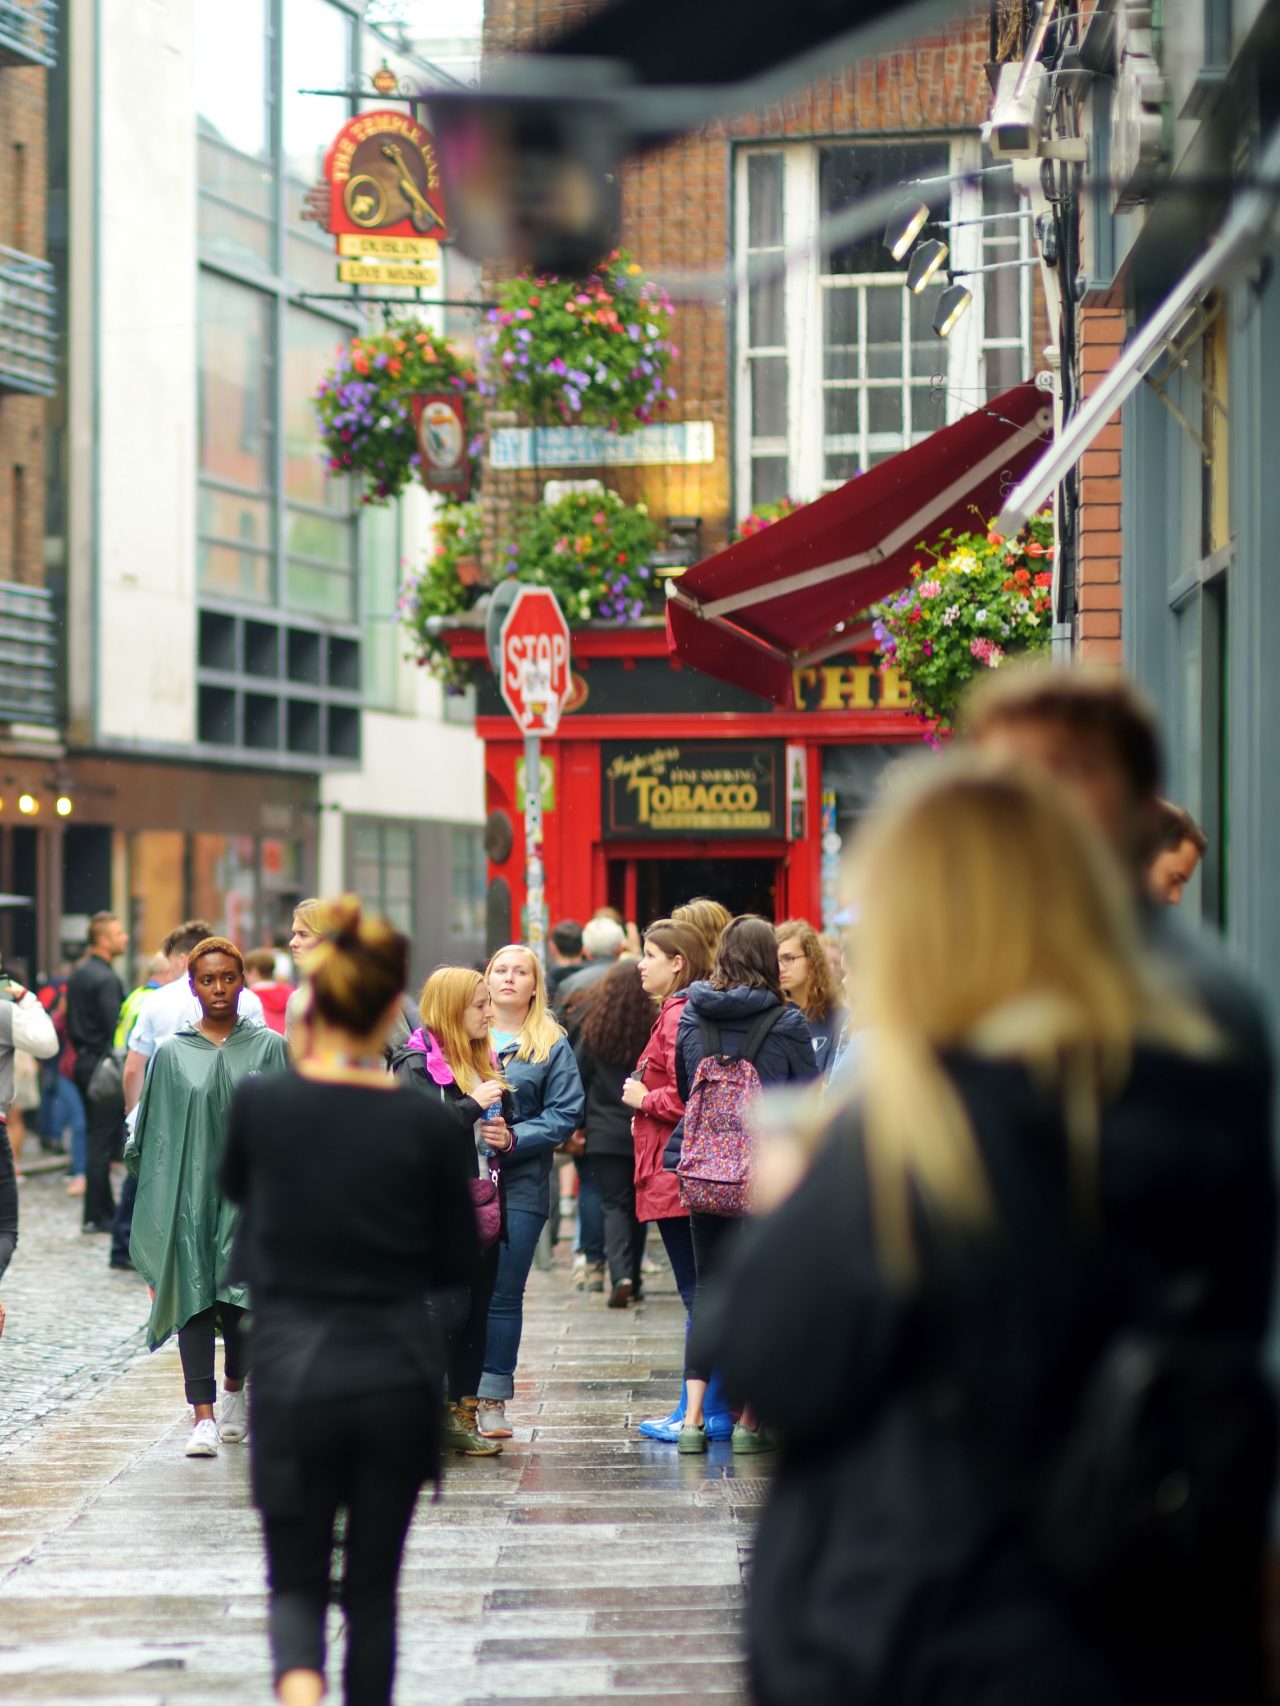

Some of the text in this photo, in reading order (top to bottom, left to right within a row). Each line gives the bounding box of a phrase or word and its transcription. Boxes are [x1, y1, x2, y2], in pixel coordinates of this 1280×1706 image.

[332, 137, 357, 182] THE
[349, 114, 422, 142] TEMPLE
[361, 239, 419, 254] DUBLIN
[793, 666, 912, 710] THE
[627, 776, 758, 823] TOBACCO
